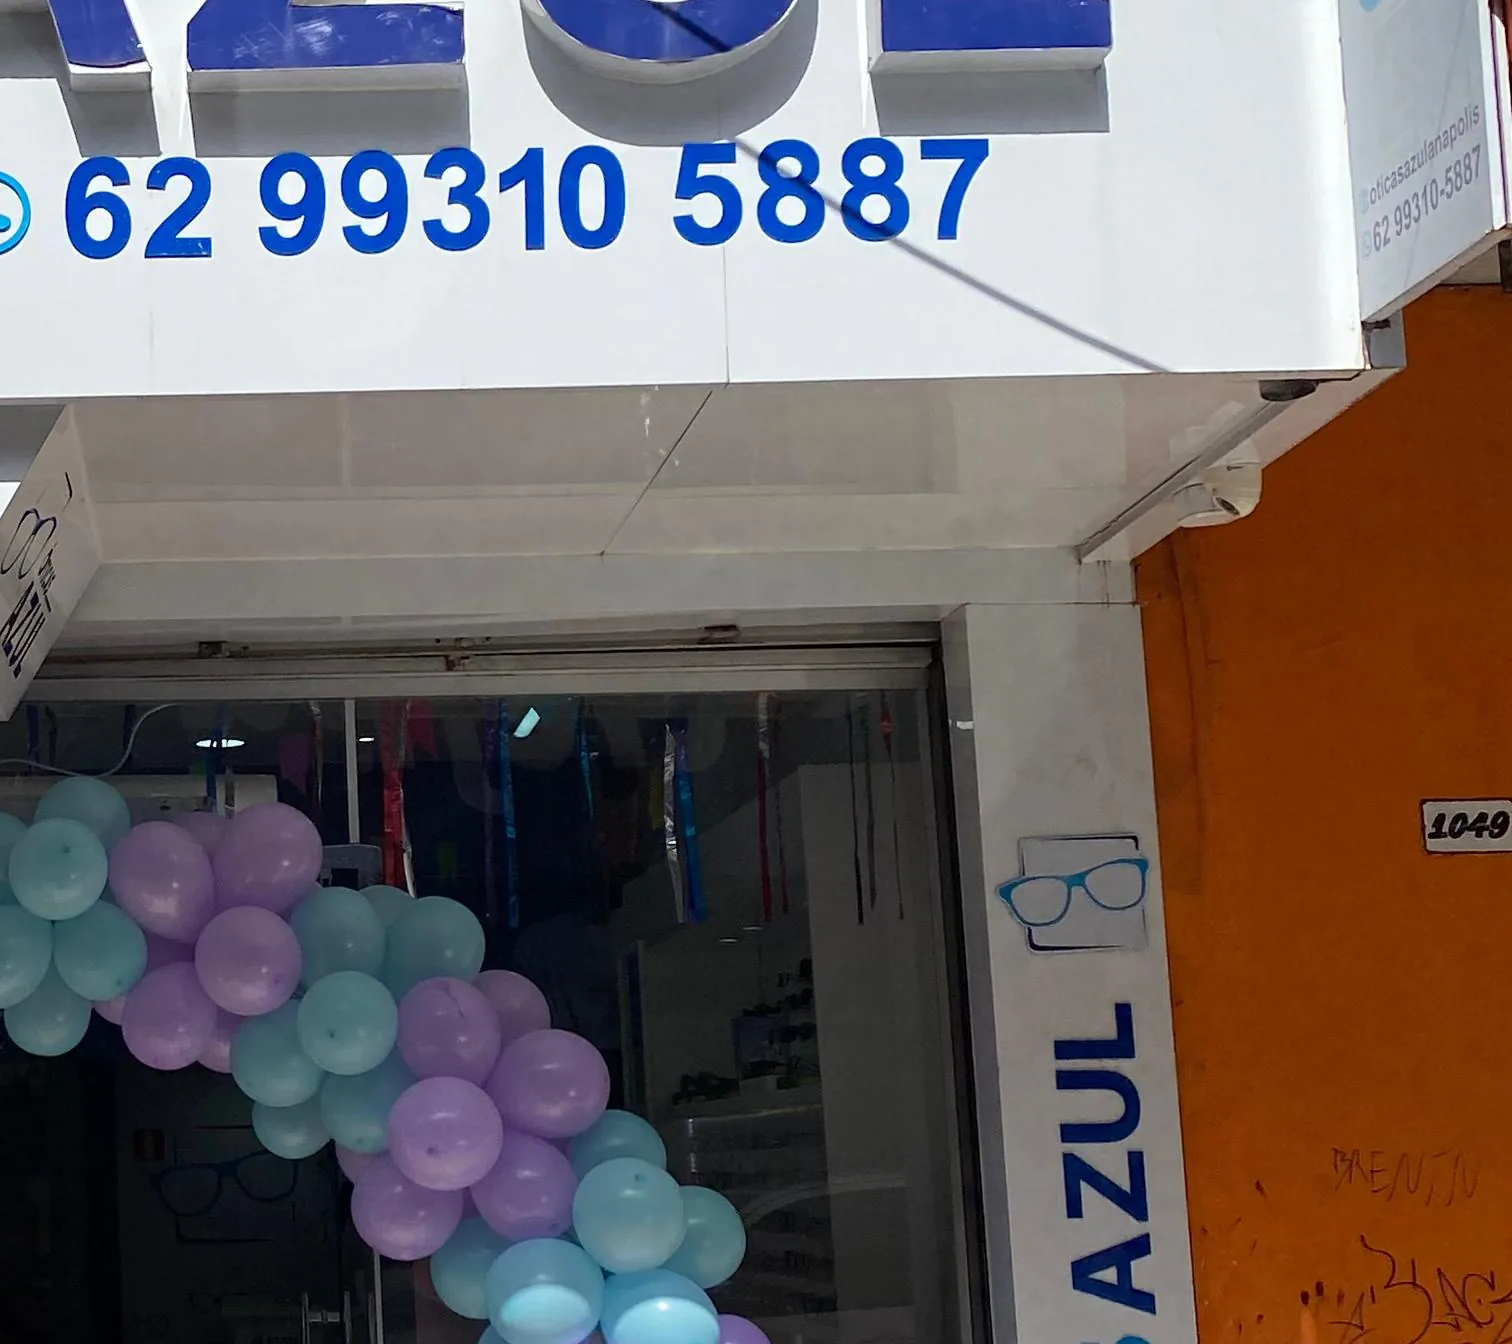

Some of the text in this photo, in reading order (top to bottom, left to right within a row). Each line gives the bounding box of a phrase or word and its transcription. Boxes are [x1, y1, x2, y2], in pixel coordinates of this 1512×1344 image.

[63, 136, 990, 259] 62 99310 5887
[1373, 144, 1481, 252] 62 99310-5887
[1427, 810, 1510, 839] 1049
[1054, 1002, 1157, 1315] AZUL
